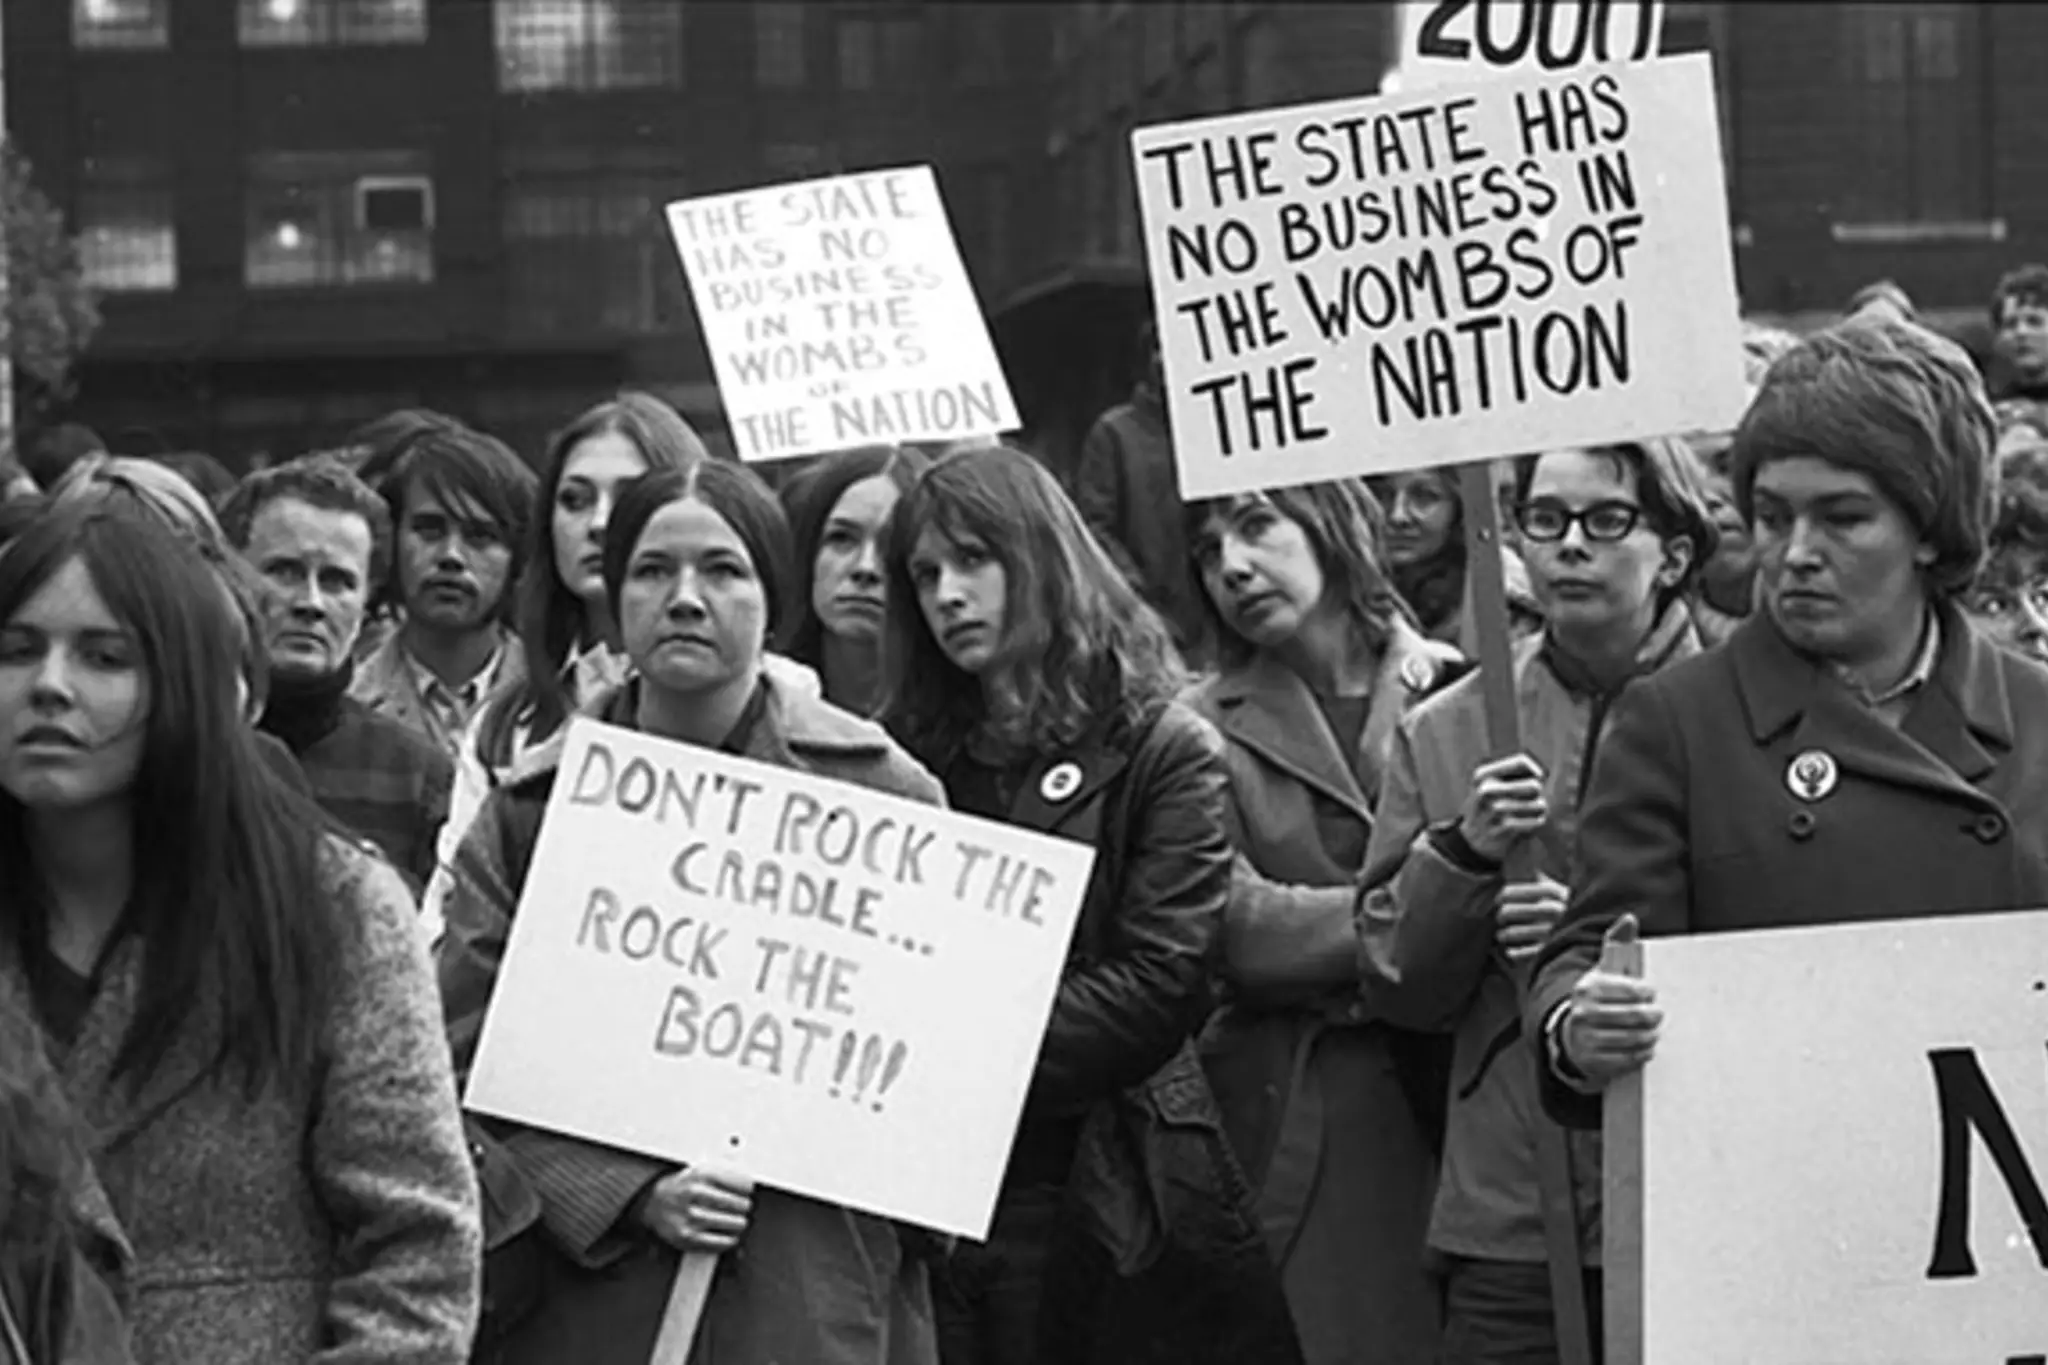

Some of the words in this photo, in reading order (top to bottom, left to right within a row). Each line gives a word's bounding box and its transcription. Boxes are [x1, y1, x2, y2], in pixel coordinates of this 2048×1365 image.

[1145, 134, 1282, 209] THE
[1298, 100, 1484, 186] STATE
[1517, 75, 1628, 155] HAS
[680, 200, 755, 242] THE
[780, 175, 917, 227] STATE
[694, 238, 786, 277] HAS
[819, 228, 889, 261] NO
[1169, 220, 1257, 281] NO
[1281, 161, 1557, 262] BUSINESS
[1580, 151, 1636, 212] IN
[709, 263, 944, 311] BUSINESS
[746, 313, 788, 342] IN
[817, 296, 919, 331] THE
[1178, 281, 1287, 361] THE
[1297, 228, 1553, 339] WOMBS
[1566, 216, 1643, 285] OF
[729, 334, 928, 385] WOMBS
[737, 407, 811, 453] THE
[831, 381, 1002, 439] NATION
[1192, 358, 1327, 455] THE
[1372, 300, 1630, 426] NATION
[570, 742, 763, 834] DON'T
[774, 790, 936, 884] ROCK
[954, 840, 1056, 927] THE
[576, 887, 729, 980] ROCK
[756, 936, 860, 1016] THE
[672, 843, 935, 956] CRADLE...
[655, 985, 908, 1114] BOAT!!!
